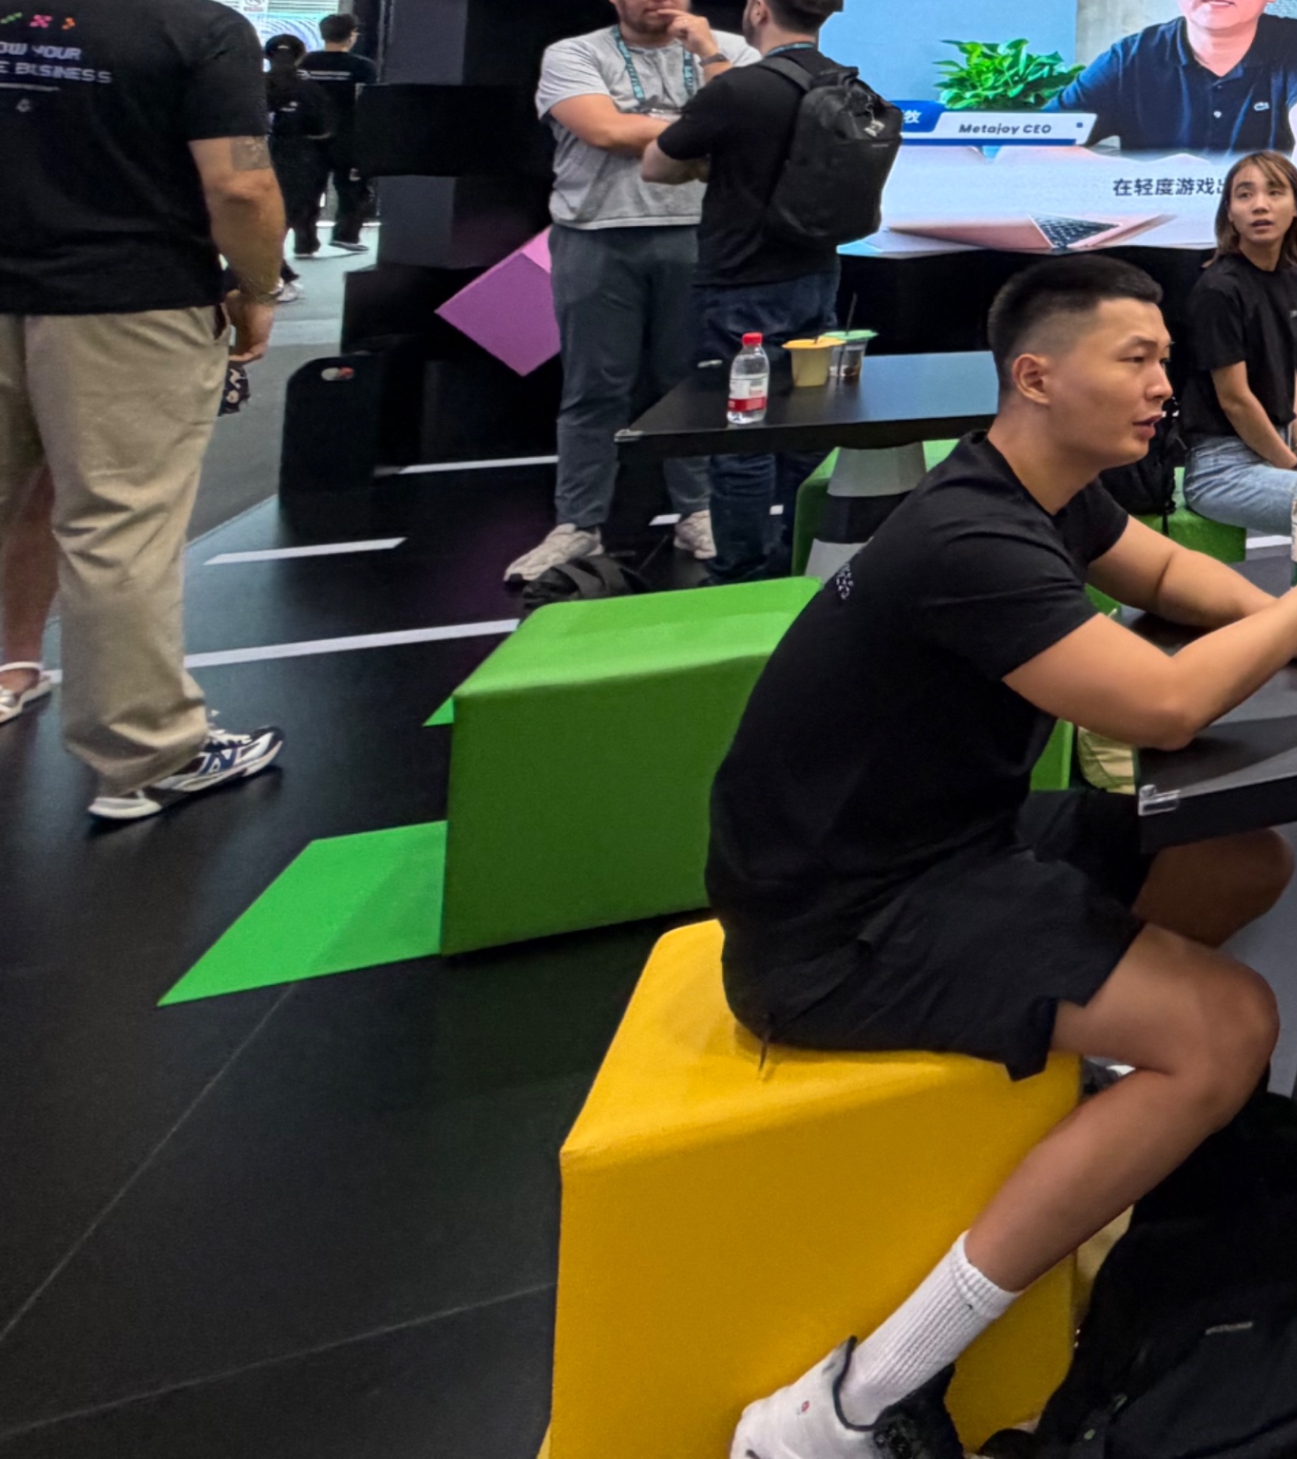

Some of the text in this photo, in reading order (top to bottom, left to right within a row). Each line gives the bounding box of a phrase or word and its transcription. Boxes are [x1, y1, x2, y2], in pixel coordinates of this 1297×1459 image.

[0, 41, 82, 60] OW YOUR
[15, 62, 112, 84] BUSINESS
[958, 123, 1052, 136] Metajoy CEO
